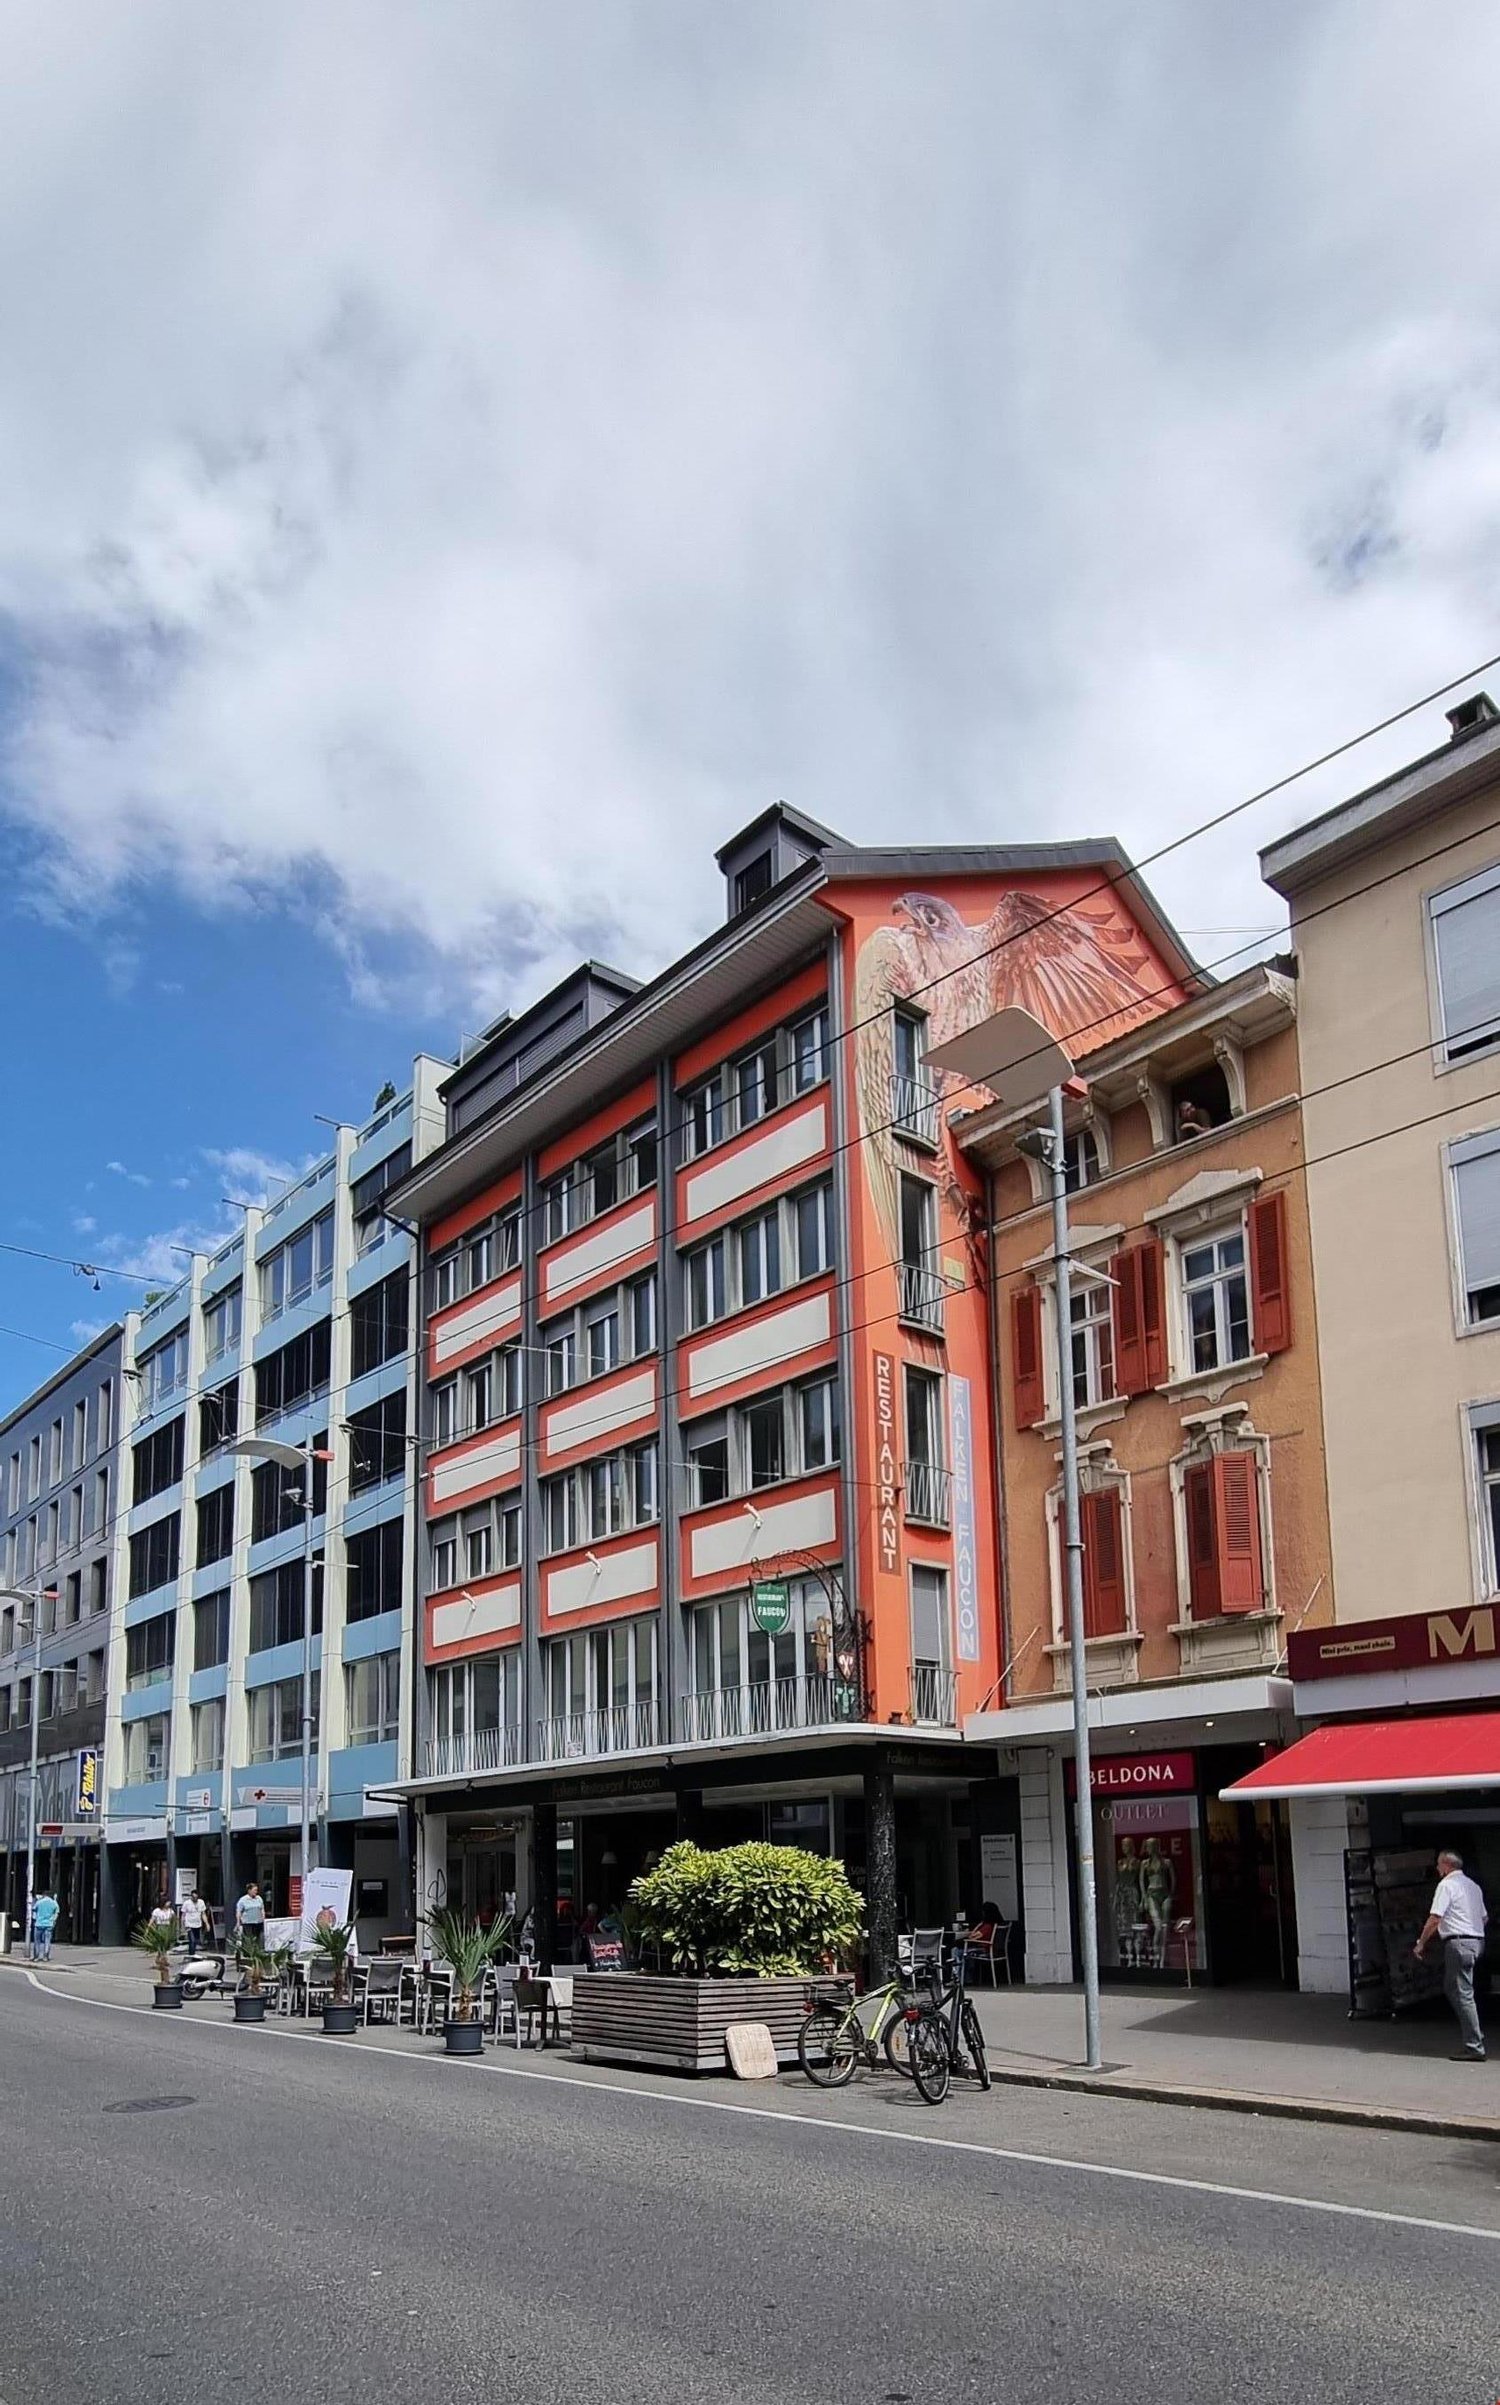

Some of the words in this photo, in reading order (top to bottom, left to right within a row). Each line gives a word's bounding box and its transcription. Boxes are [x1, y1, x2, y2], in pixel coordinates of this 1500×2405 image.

[876, 1355, 897, 1570] RESTAURANT
[953, 1382, 969, 1503] FALKEN
[958, 1524, 975, 1654] FAUCON
[82, 1753, 95, 1796] Tchibo
[1089, 1764, 1174, 1785] BELDONA
[1100, 1803, 1167, 1820] OUTLET
